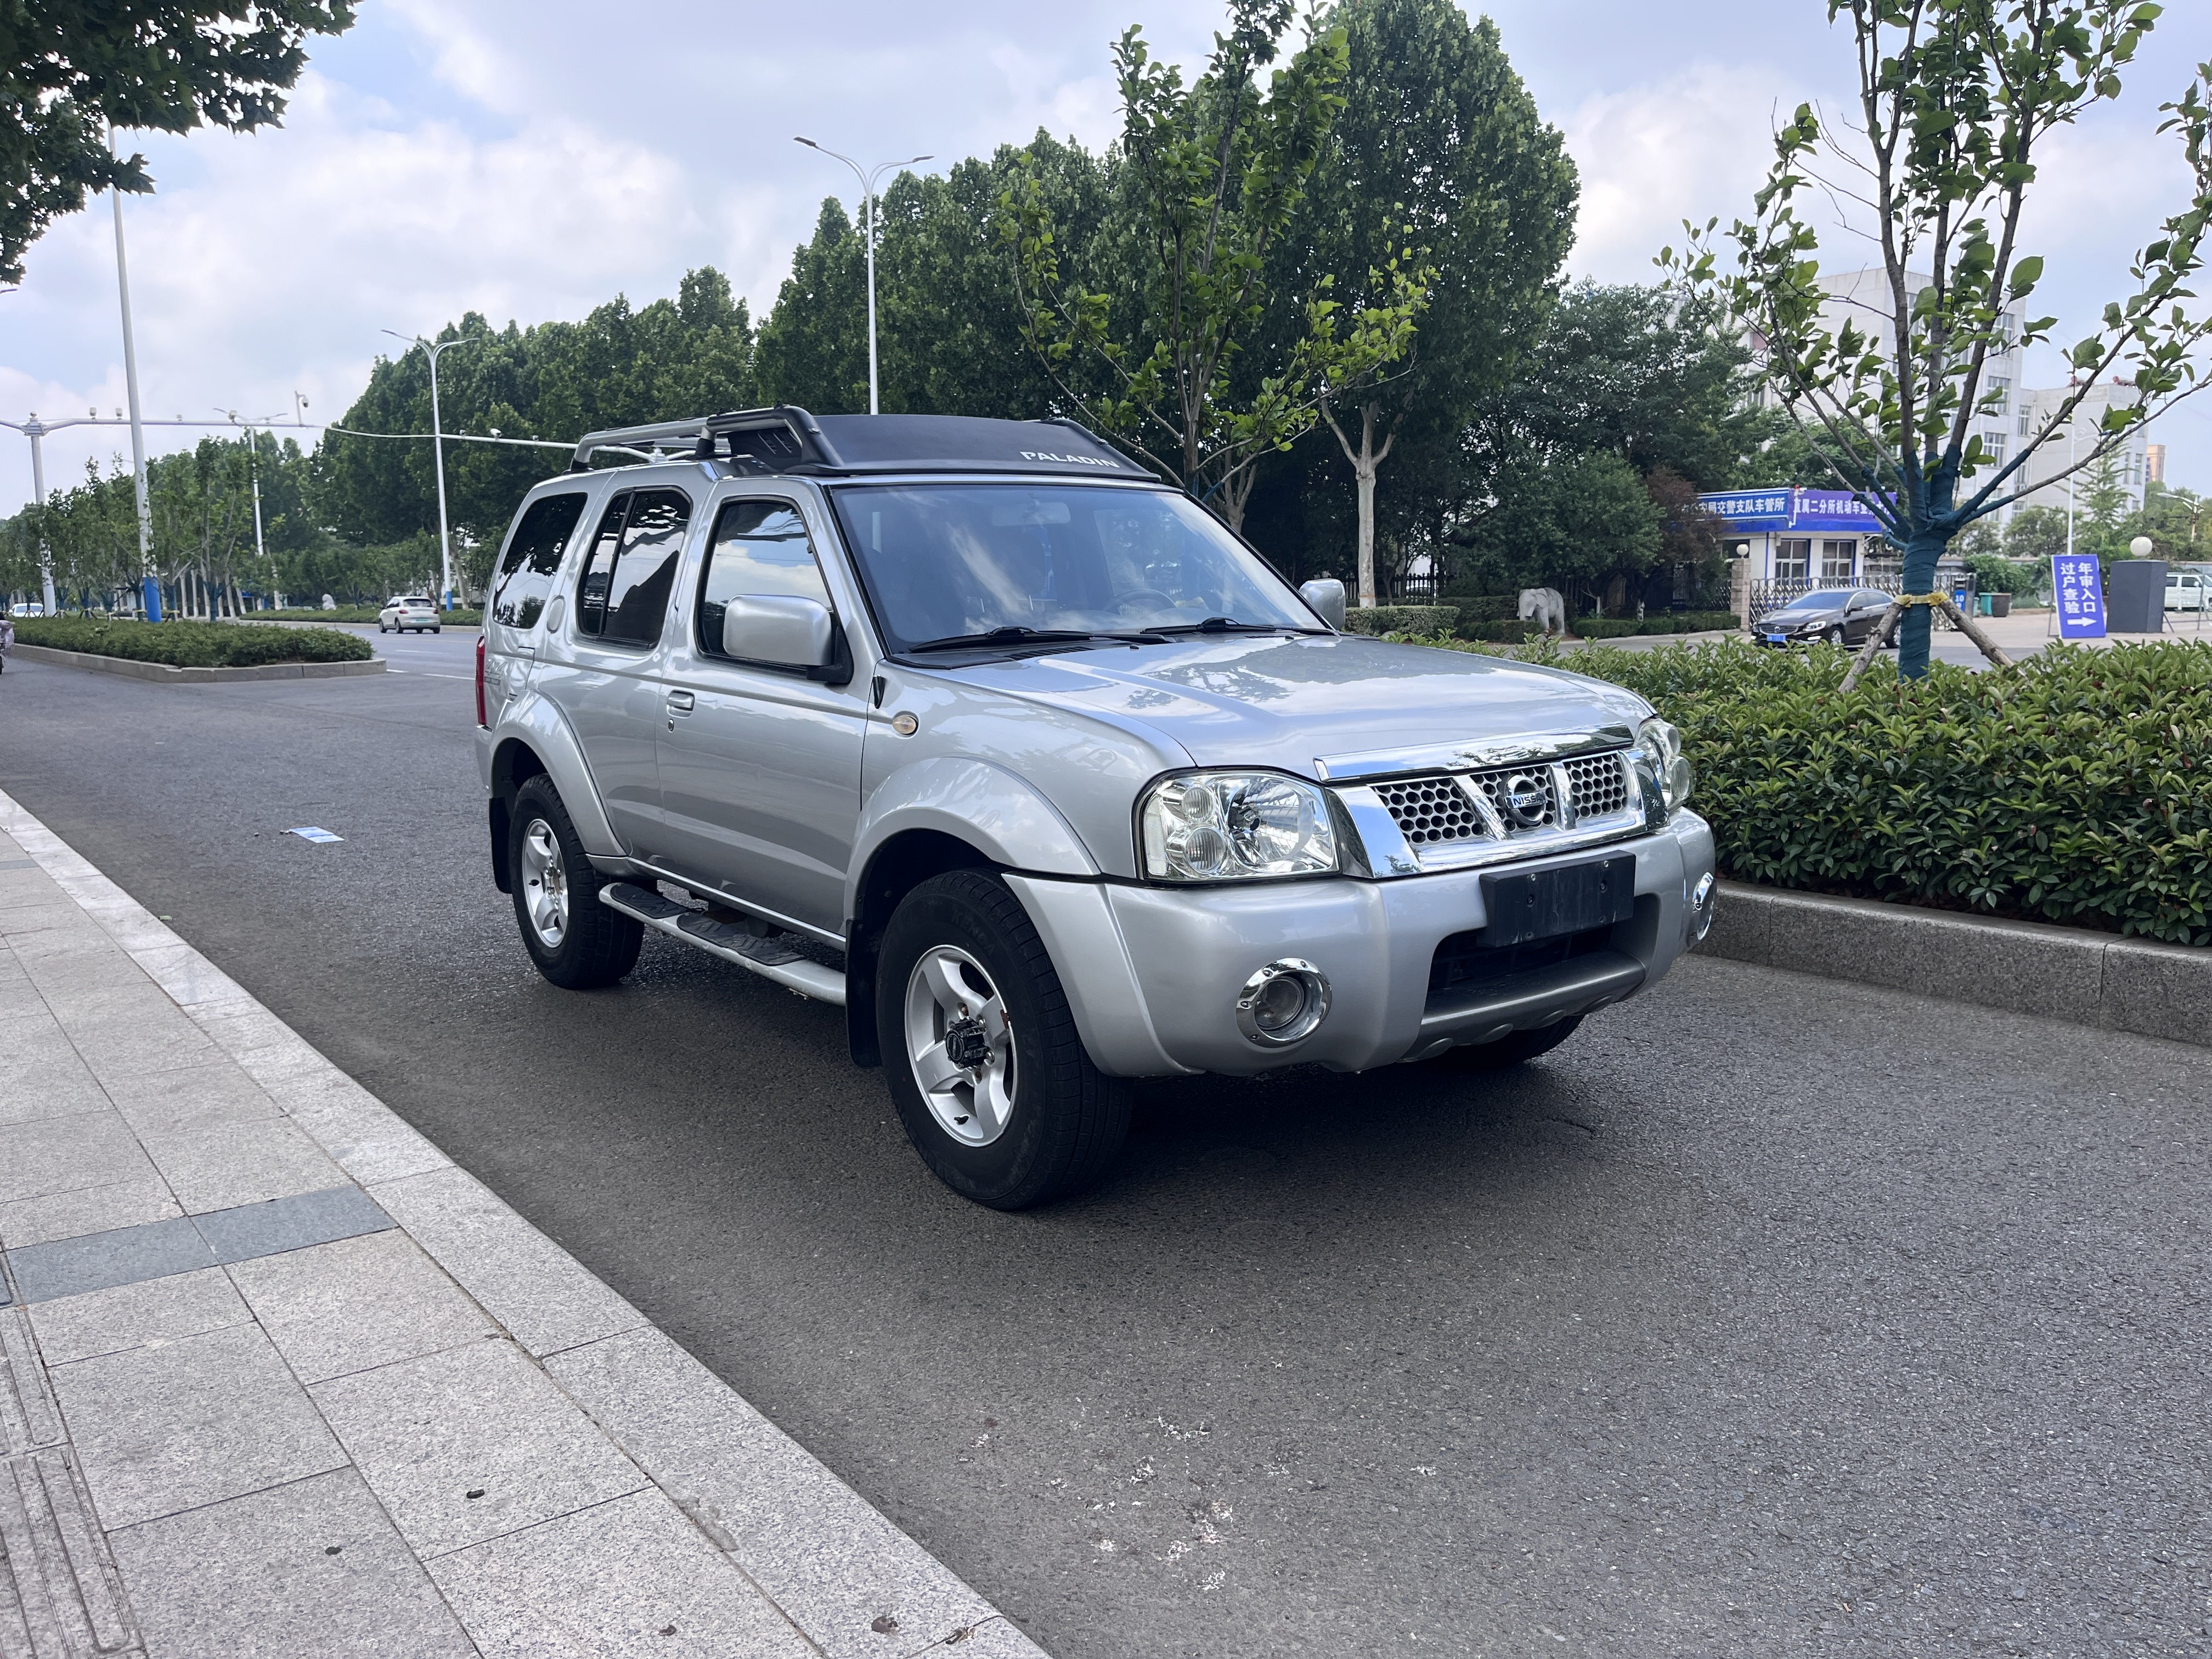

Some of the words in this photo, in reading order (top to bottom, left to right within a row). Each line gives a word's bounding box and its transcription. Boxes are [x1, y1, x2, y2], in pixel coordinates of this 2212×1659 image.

[1019, 451, 1120, 468] PALADIN
[2060, 562, 2080, 614] 过户查验
[2078, 562, 2096, 613] 年审入口
